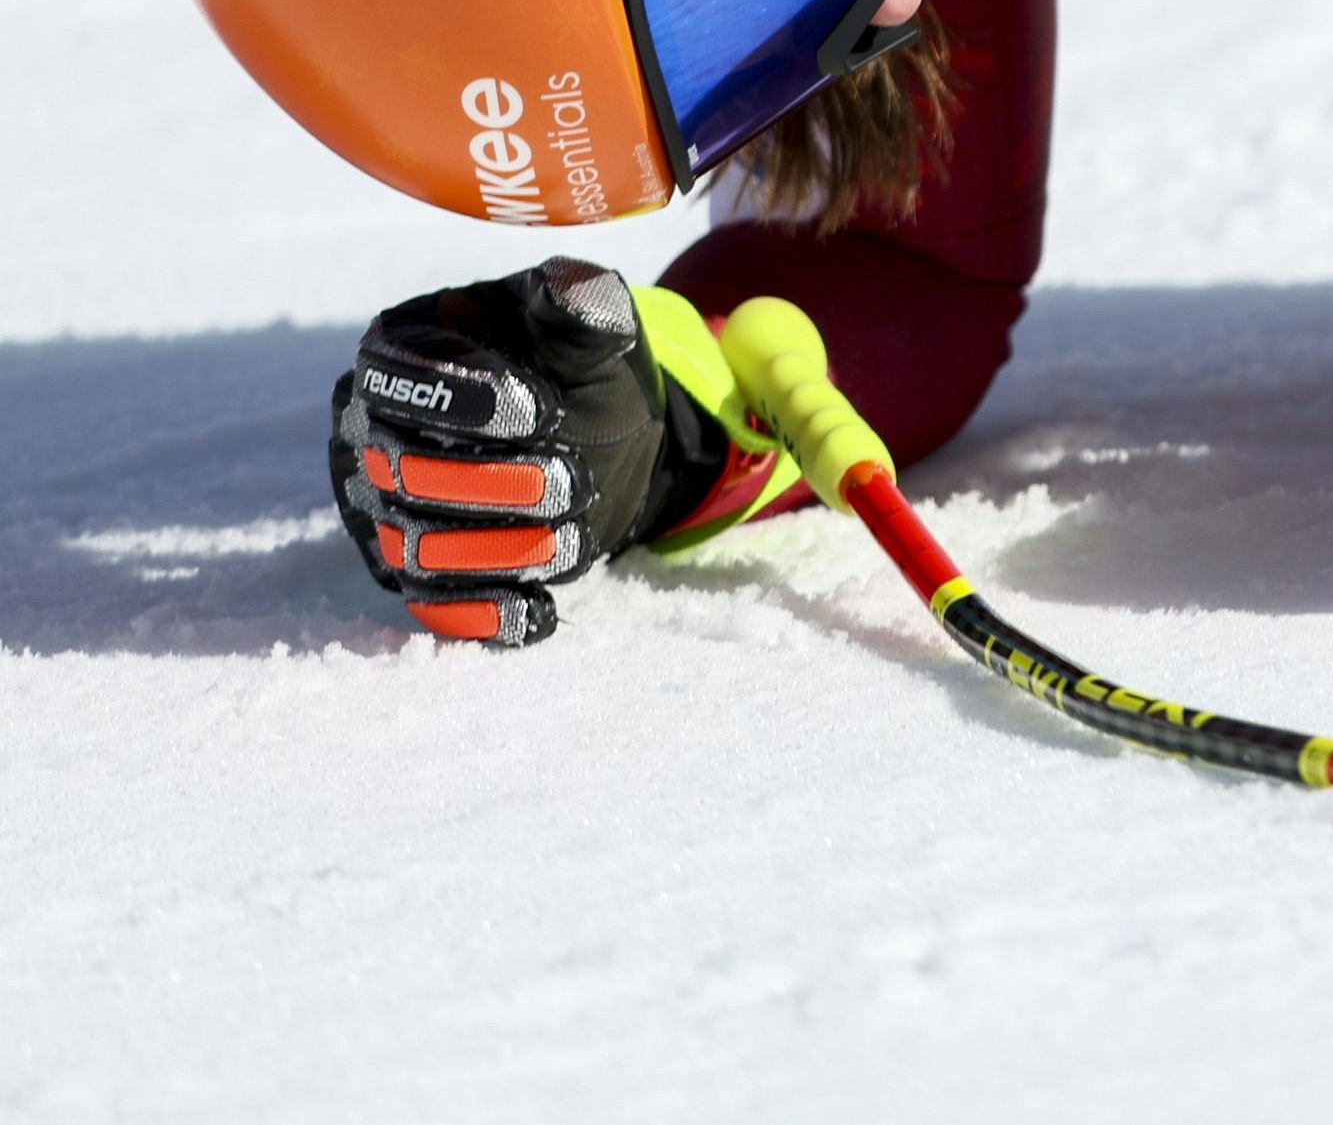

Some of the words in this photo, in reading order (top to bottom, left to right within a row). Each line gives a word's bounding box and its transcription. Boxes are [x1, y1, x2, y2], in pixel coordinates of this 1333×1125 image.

[461, 78, 549, 225] wkee
[541, 71, 609, 217] essentials
[363, 367, 453, 412] reusch
